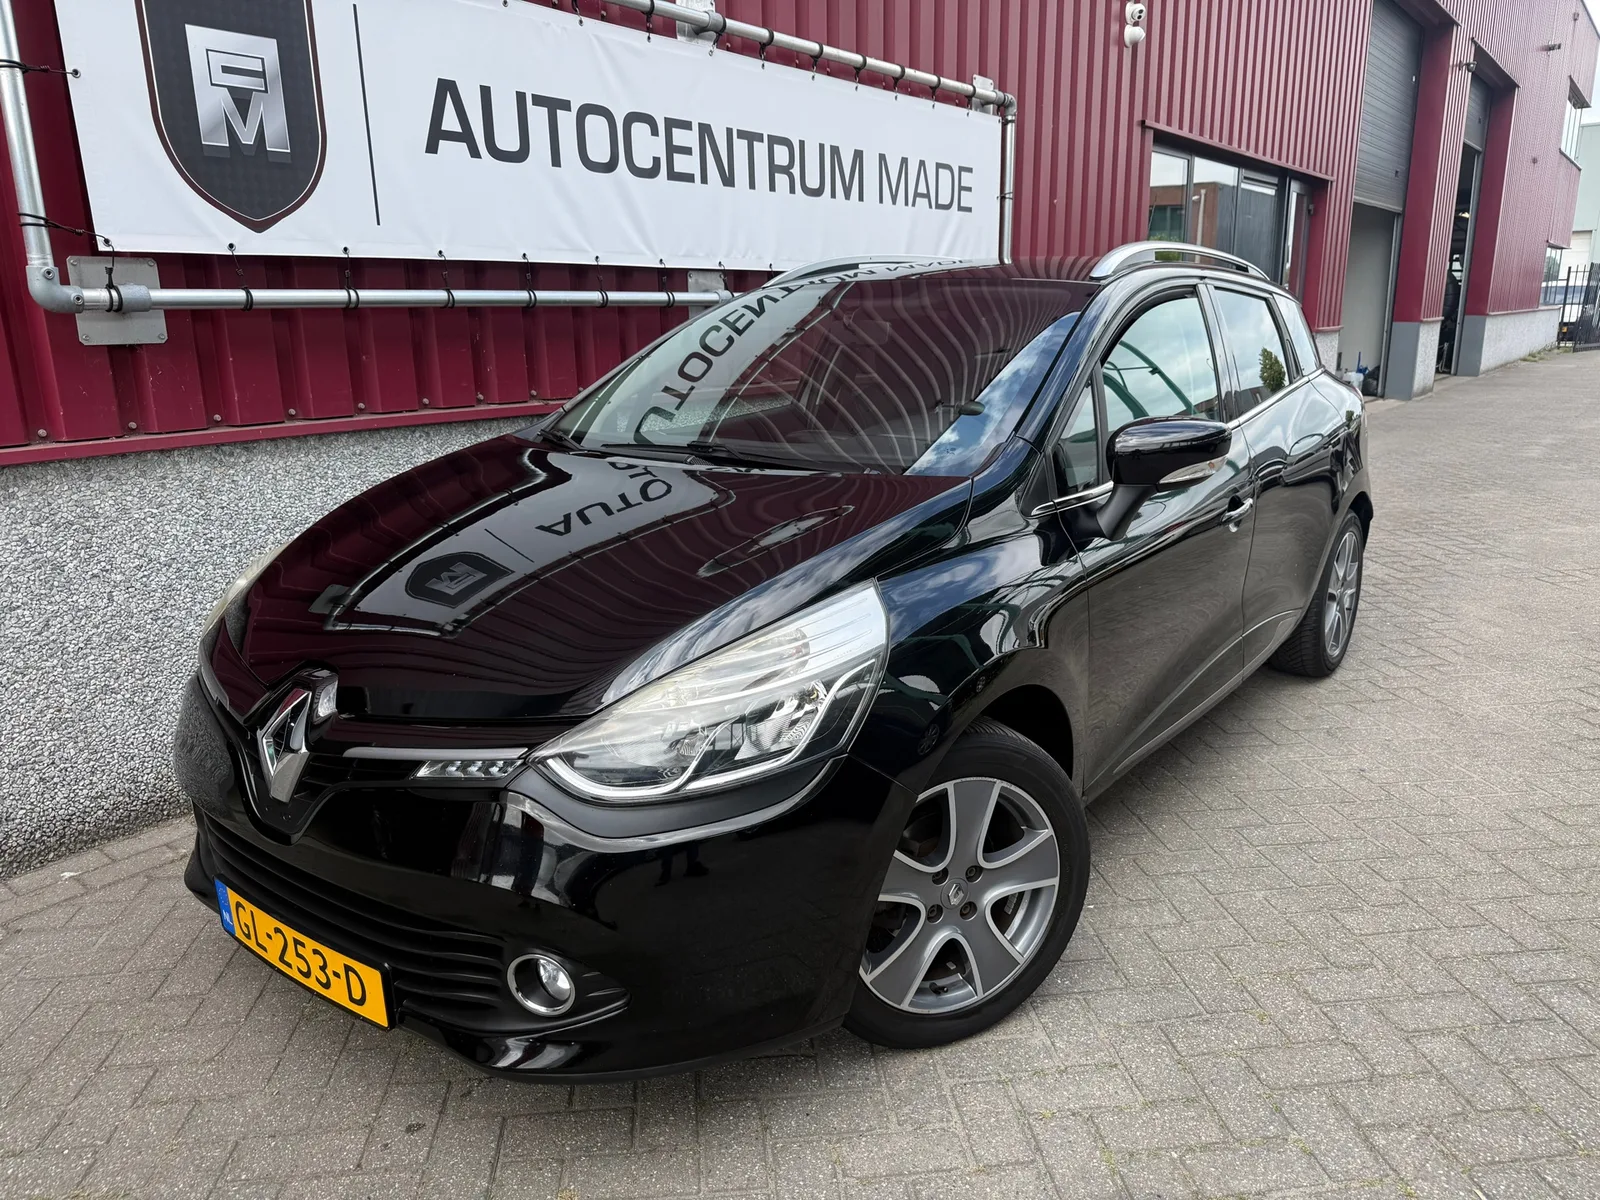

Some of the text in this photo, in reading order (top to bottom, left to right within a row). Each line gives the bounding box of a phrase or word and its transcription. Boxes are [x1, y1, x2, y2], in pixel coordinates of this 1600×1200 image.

[424, 77, 974, 213] AUTOCENTRUM MADE
[222, 909, 234, 925] NL
[235, 900, 367, 1007] GL-253-D
